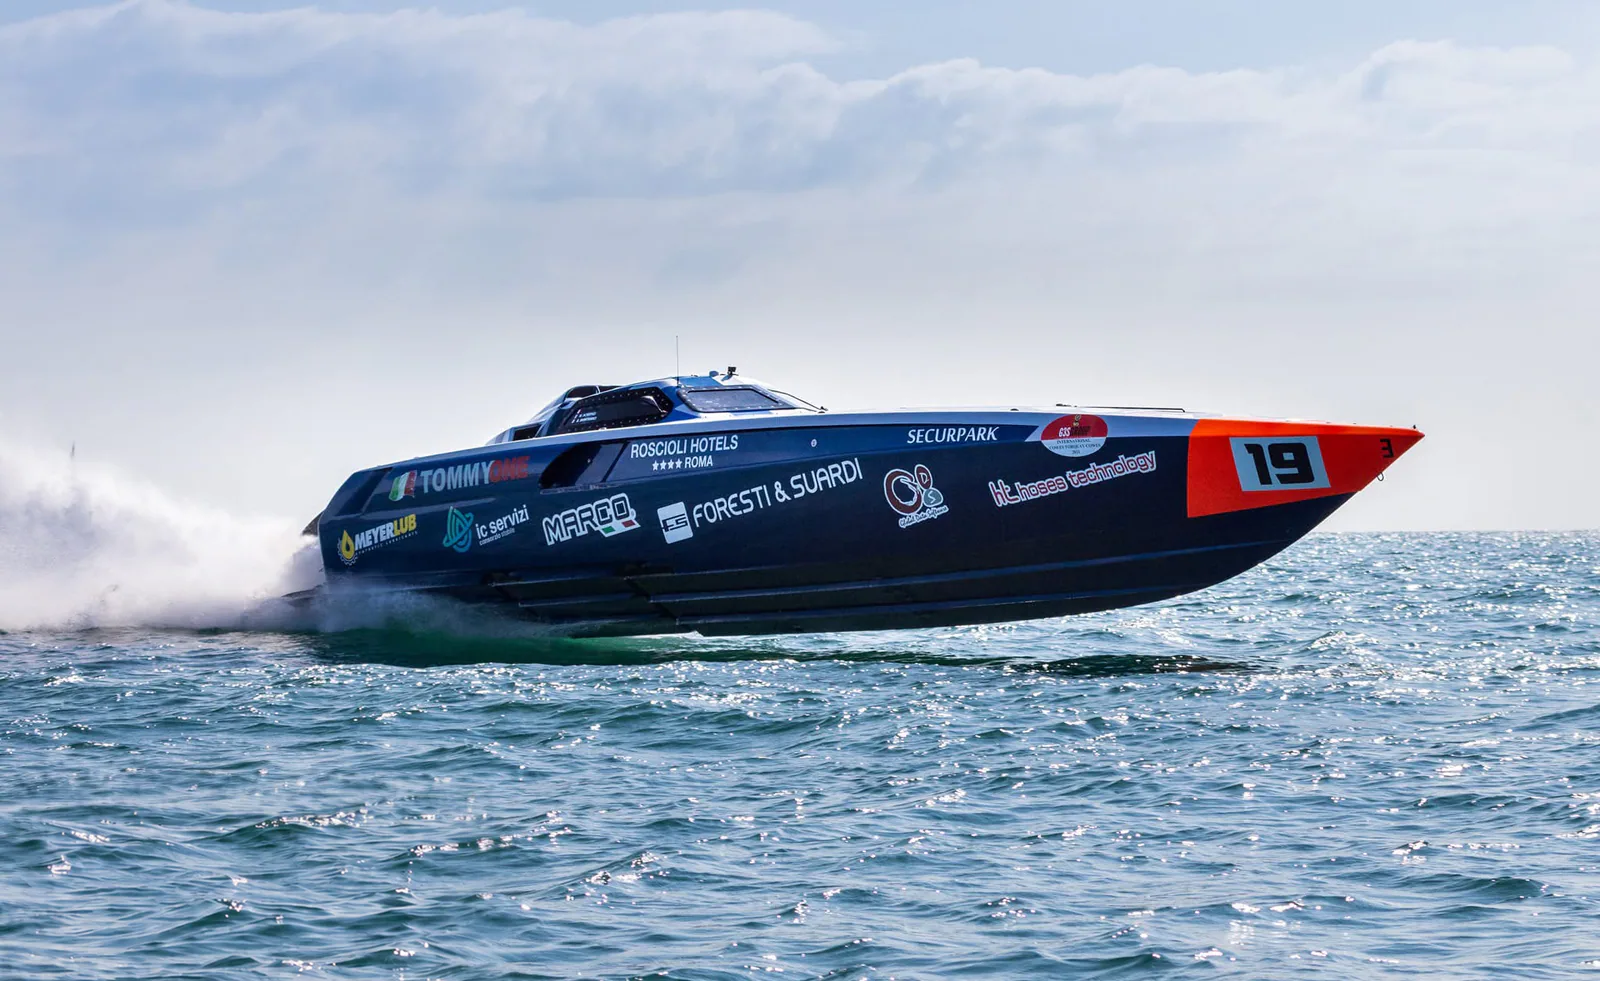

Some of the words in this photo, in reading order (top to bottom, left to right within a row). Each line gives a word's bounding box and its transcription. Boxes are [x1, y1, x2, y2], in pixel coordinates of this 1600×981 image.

[631, 440, 687, 459] ROSCIOLI
[691, 435, 738, 453] HOTELS
[907, 427, 999, 444] SECURPARK
[1379, 439, 1394, 459] 3
[420, 456, 530, 493] TOMMYONE
[684, 455, 713, 469] ROMA
[1014, 476, 1069, 502] hoses
[1066, 450, 1157, 489] technology
[1244, 442, 1316, 486] 19
[692, 485, 771, 528] FORESTI
[775, 481, 791, 502] &
[790, 457, 863, 499] SUARDI
[354, 513, 417, 551] MEYERLUB
[475, 523, 488, 539] ic
[489, 504, 529, 534] servizi
[542, 492, 631, 546] MARCO
